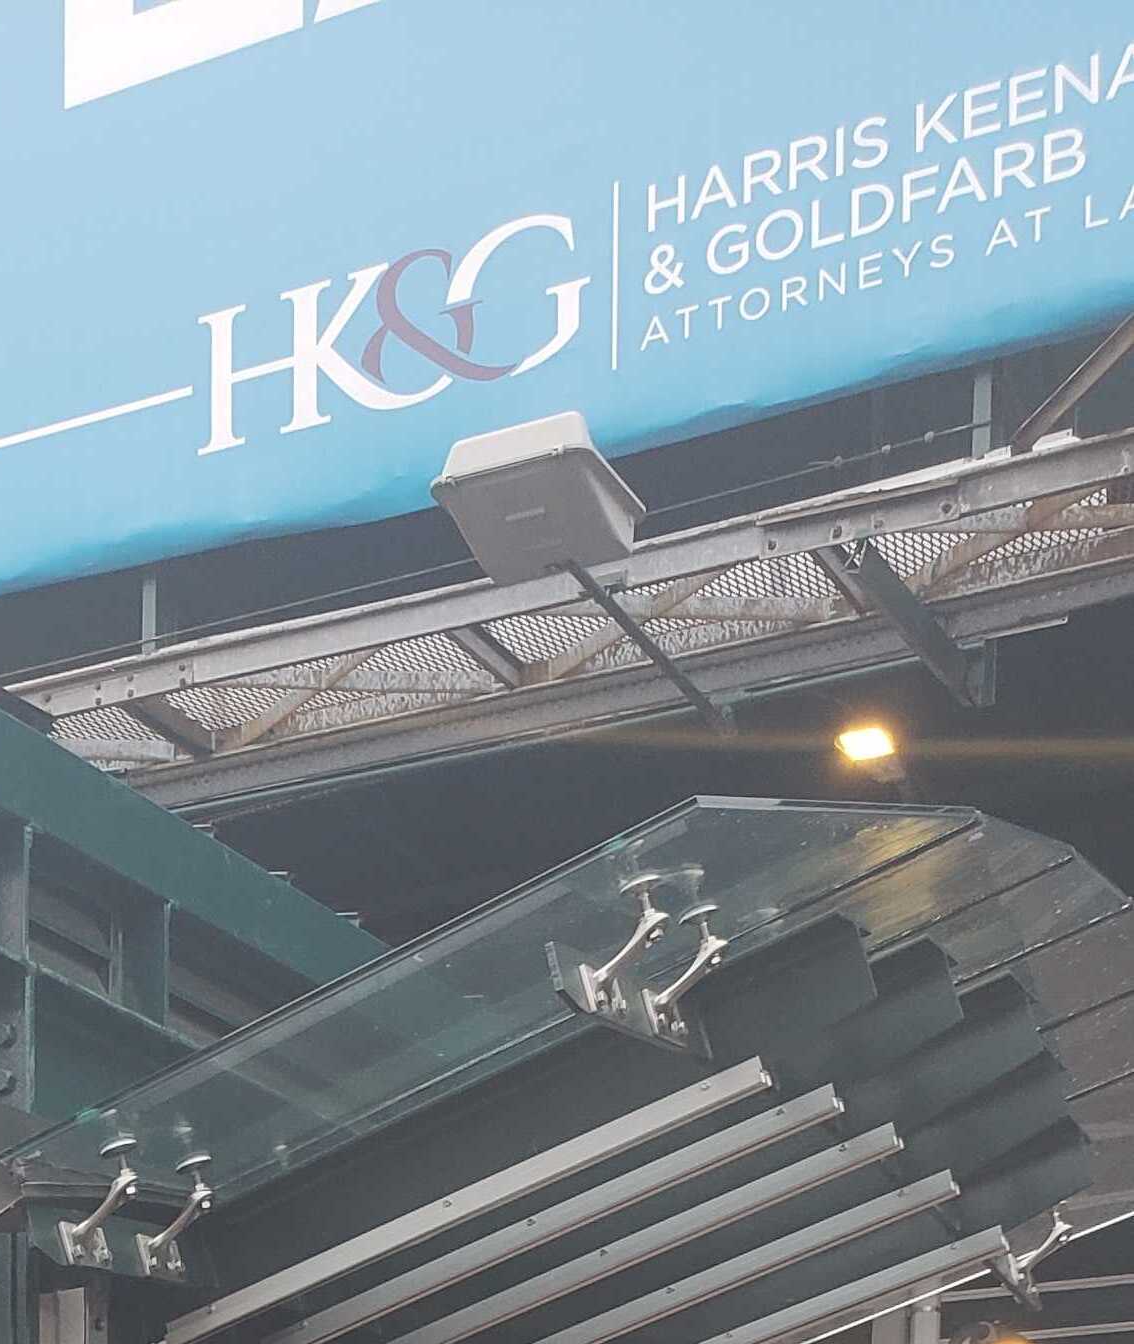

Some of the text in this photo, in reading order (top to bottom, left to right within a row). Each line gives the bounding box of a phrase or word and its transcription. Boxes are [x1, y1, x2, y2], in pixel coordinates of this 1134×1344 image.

[643, 128, 1087, 294] & GOLDFARB
[647, 116, 889, 232] HARRIS
[197, 213, 591, 456] HK&G
[640, 234, 956, 351] ATTORNEYS
[985, 206, 1052, 256] AT
